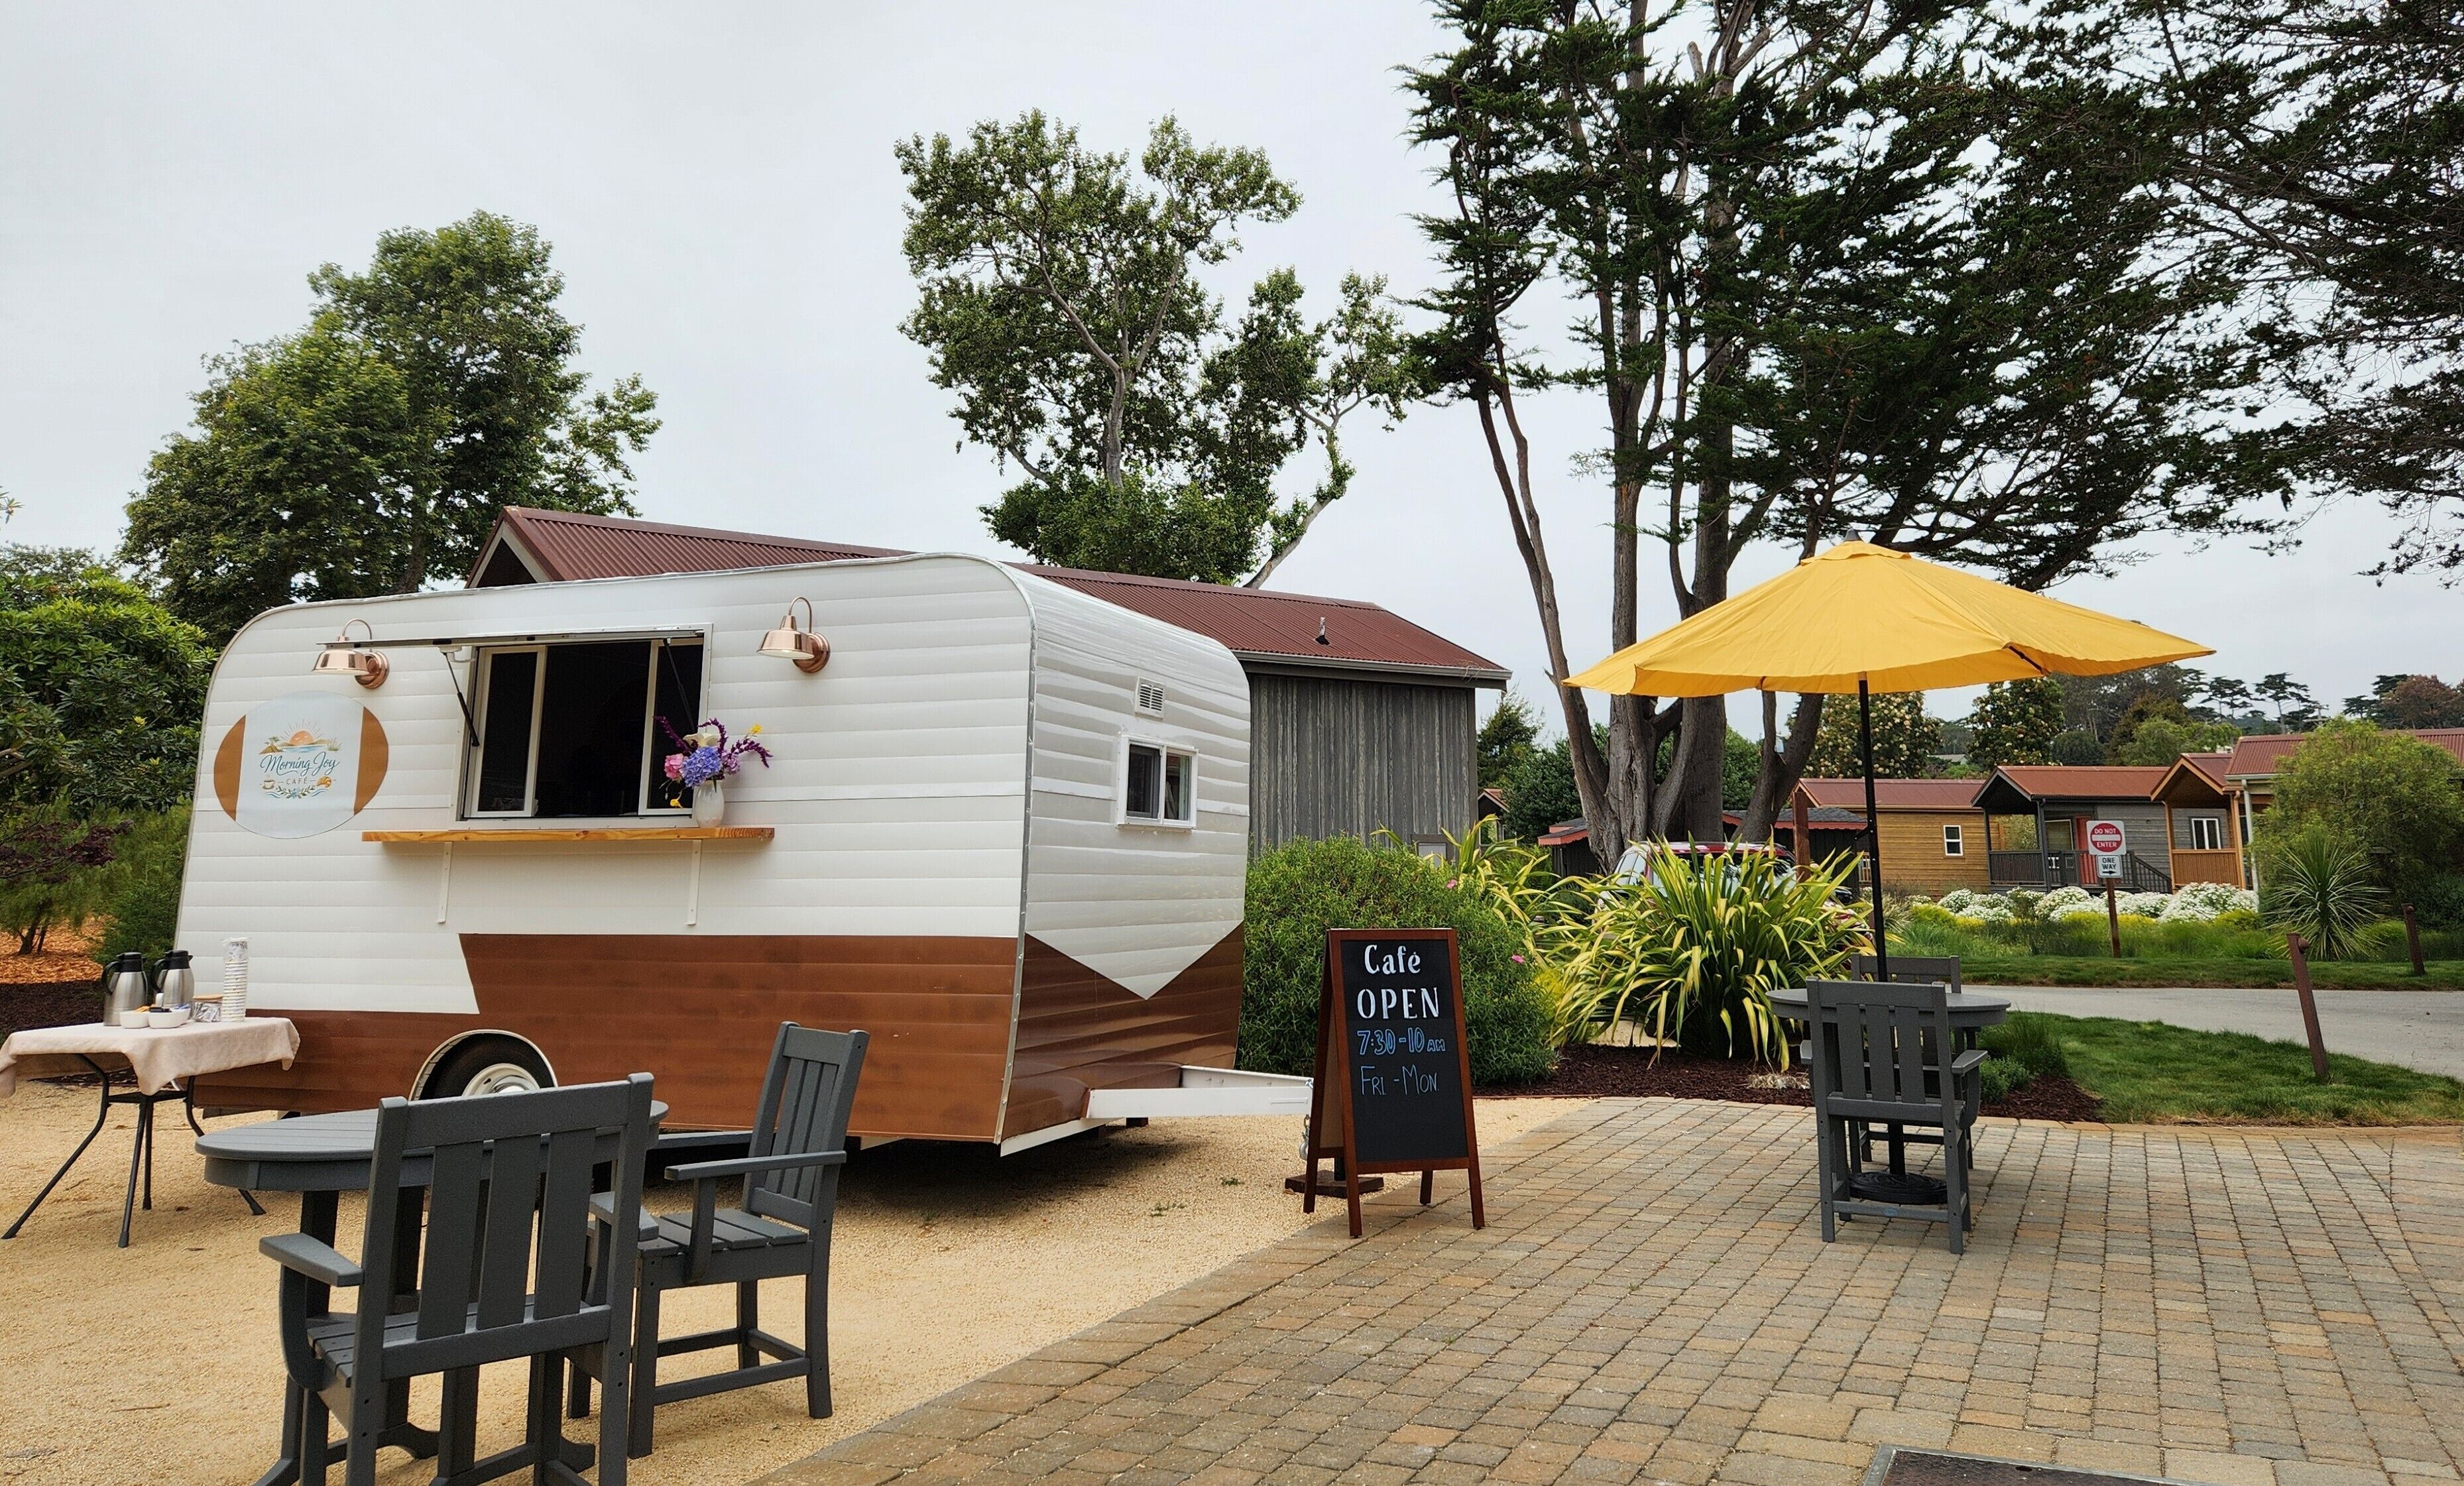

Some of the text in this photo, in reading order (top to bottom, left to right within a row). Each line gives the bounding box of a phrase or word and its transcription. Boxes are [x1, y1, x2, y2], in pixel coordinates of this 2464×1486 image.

[260, 752, 340, 776] Morning Joy
[1364, 944, 1421, 974] Café
[1357, 987, 1439, 1019] OPEN
[1427, 1038, 1446, 1052] AM
